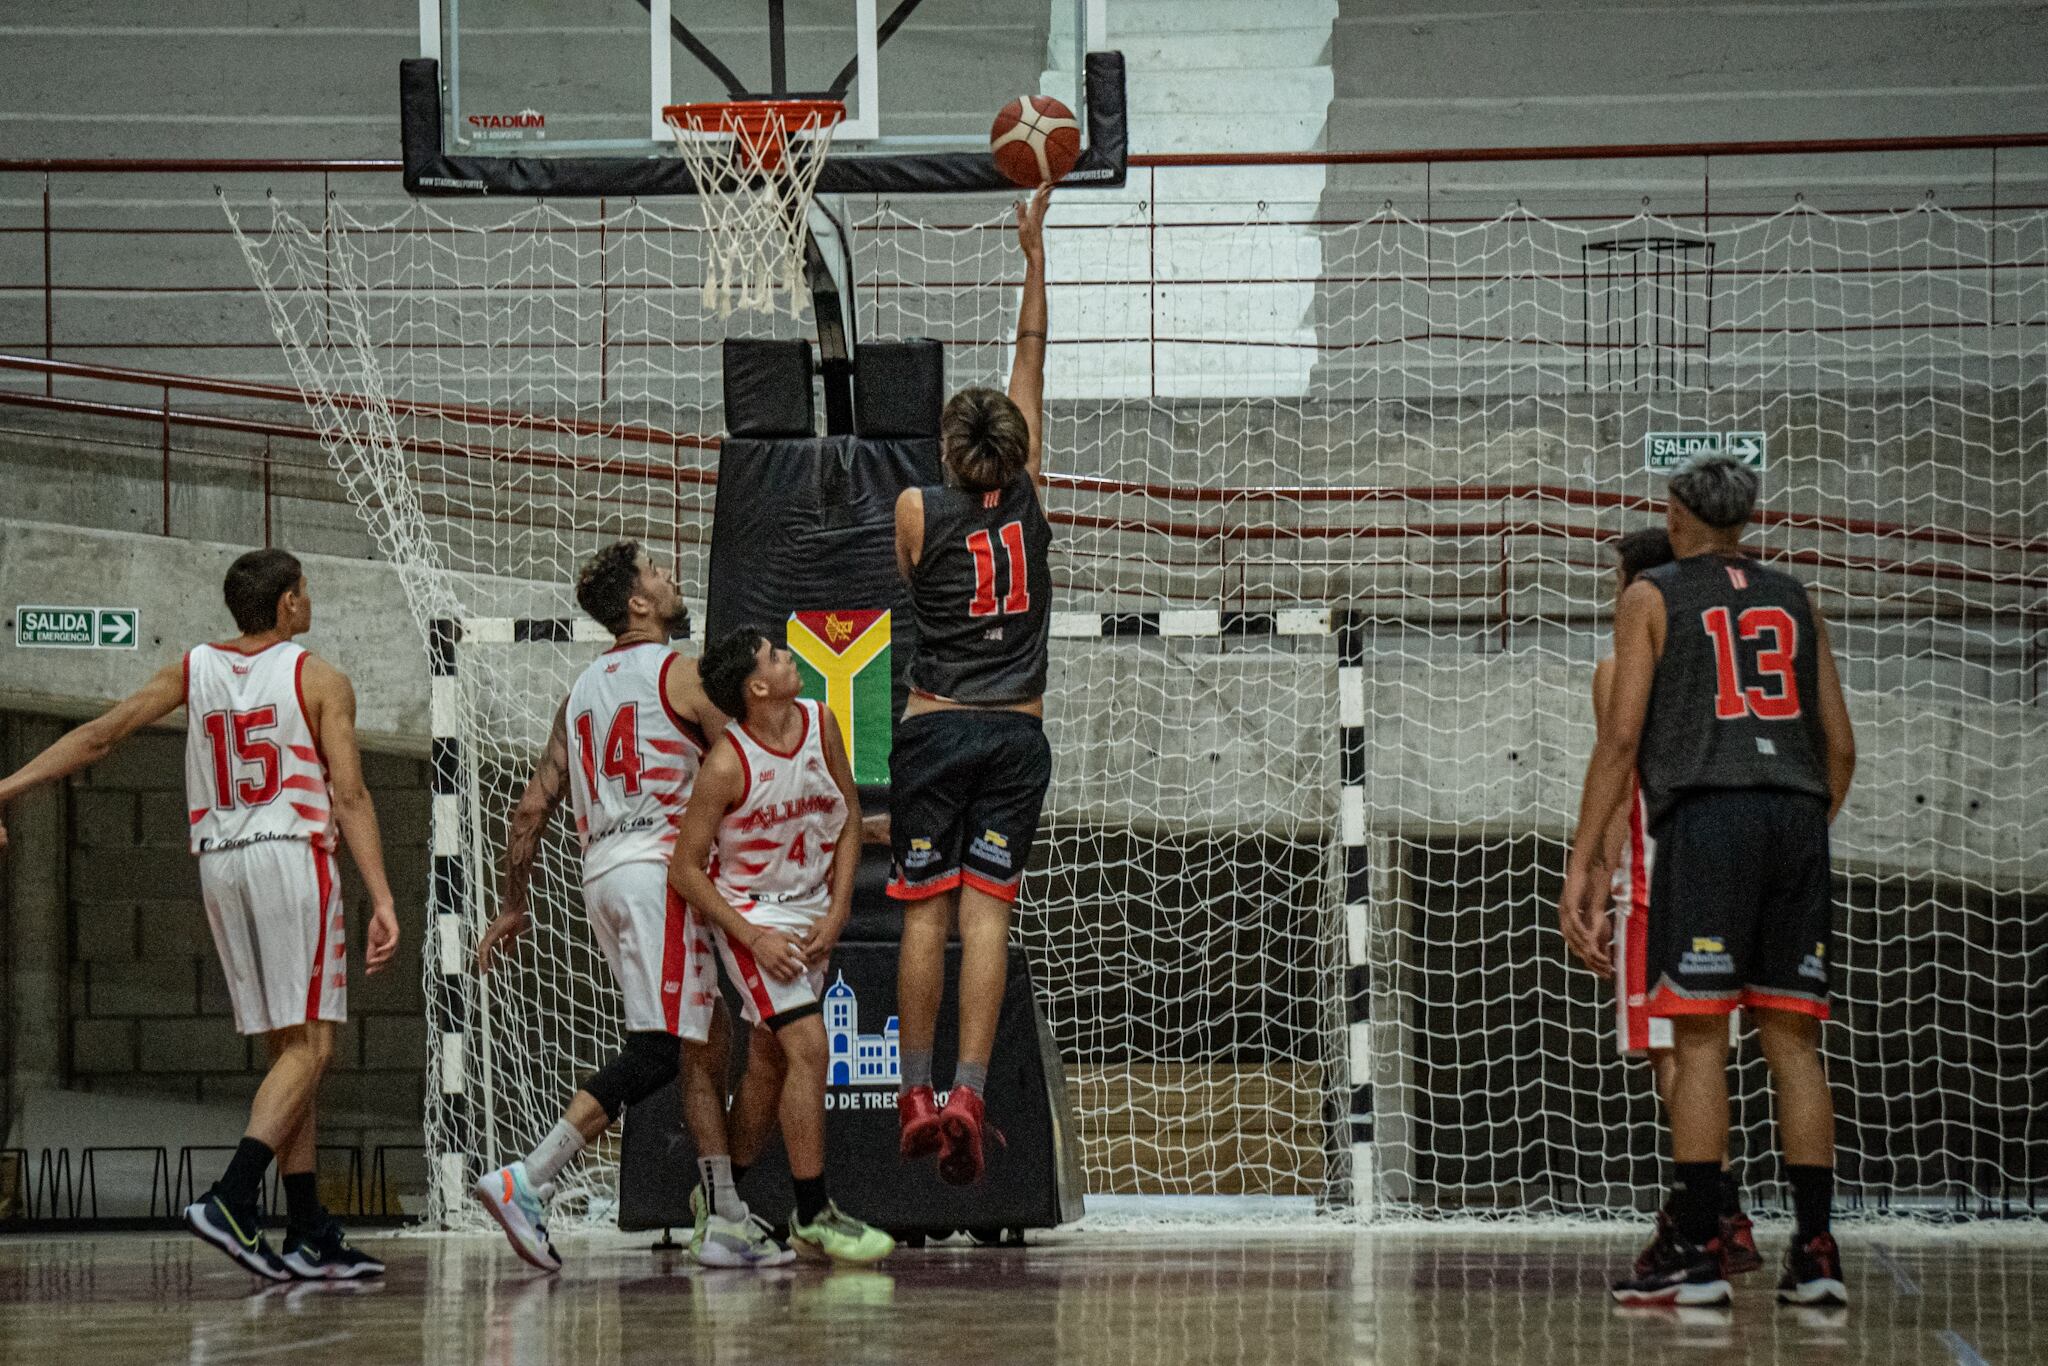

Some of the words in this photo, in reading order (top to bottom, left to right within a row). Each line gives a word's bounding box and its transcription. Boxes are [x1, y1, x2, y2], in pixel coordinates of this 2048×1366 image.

[468, 115, 545, 128] STADIUM
[1654, 438, 1711, 455] SALIDA
[1651, 456, 1663, 465] DE
[966, 520, 1031, 617] 11
[25, 613, 88, 631] SALIDA
[22, 631, 34, 640] DE
[37, 631, 90, 641] EMERGENCIA
[1701, 605, 1801, 720] 13
[203, 704, 282, 811] 15
[575, 701, 644, 804] 14
[787, 831, 807, 869] 4
[839, 1092, 860, 1110] DE
[863, 1092, 899, 1109] TRES
